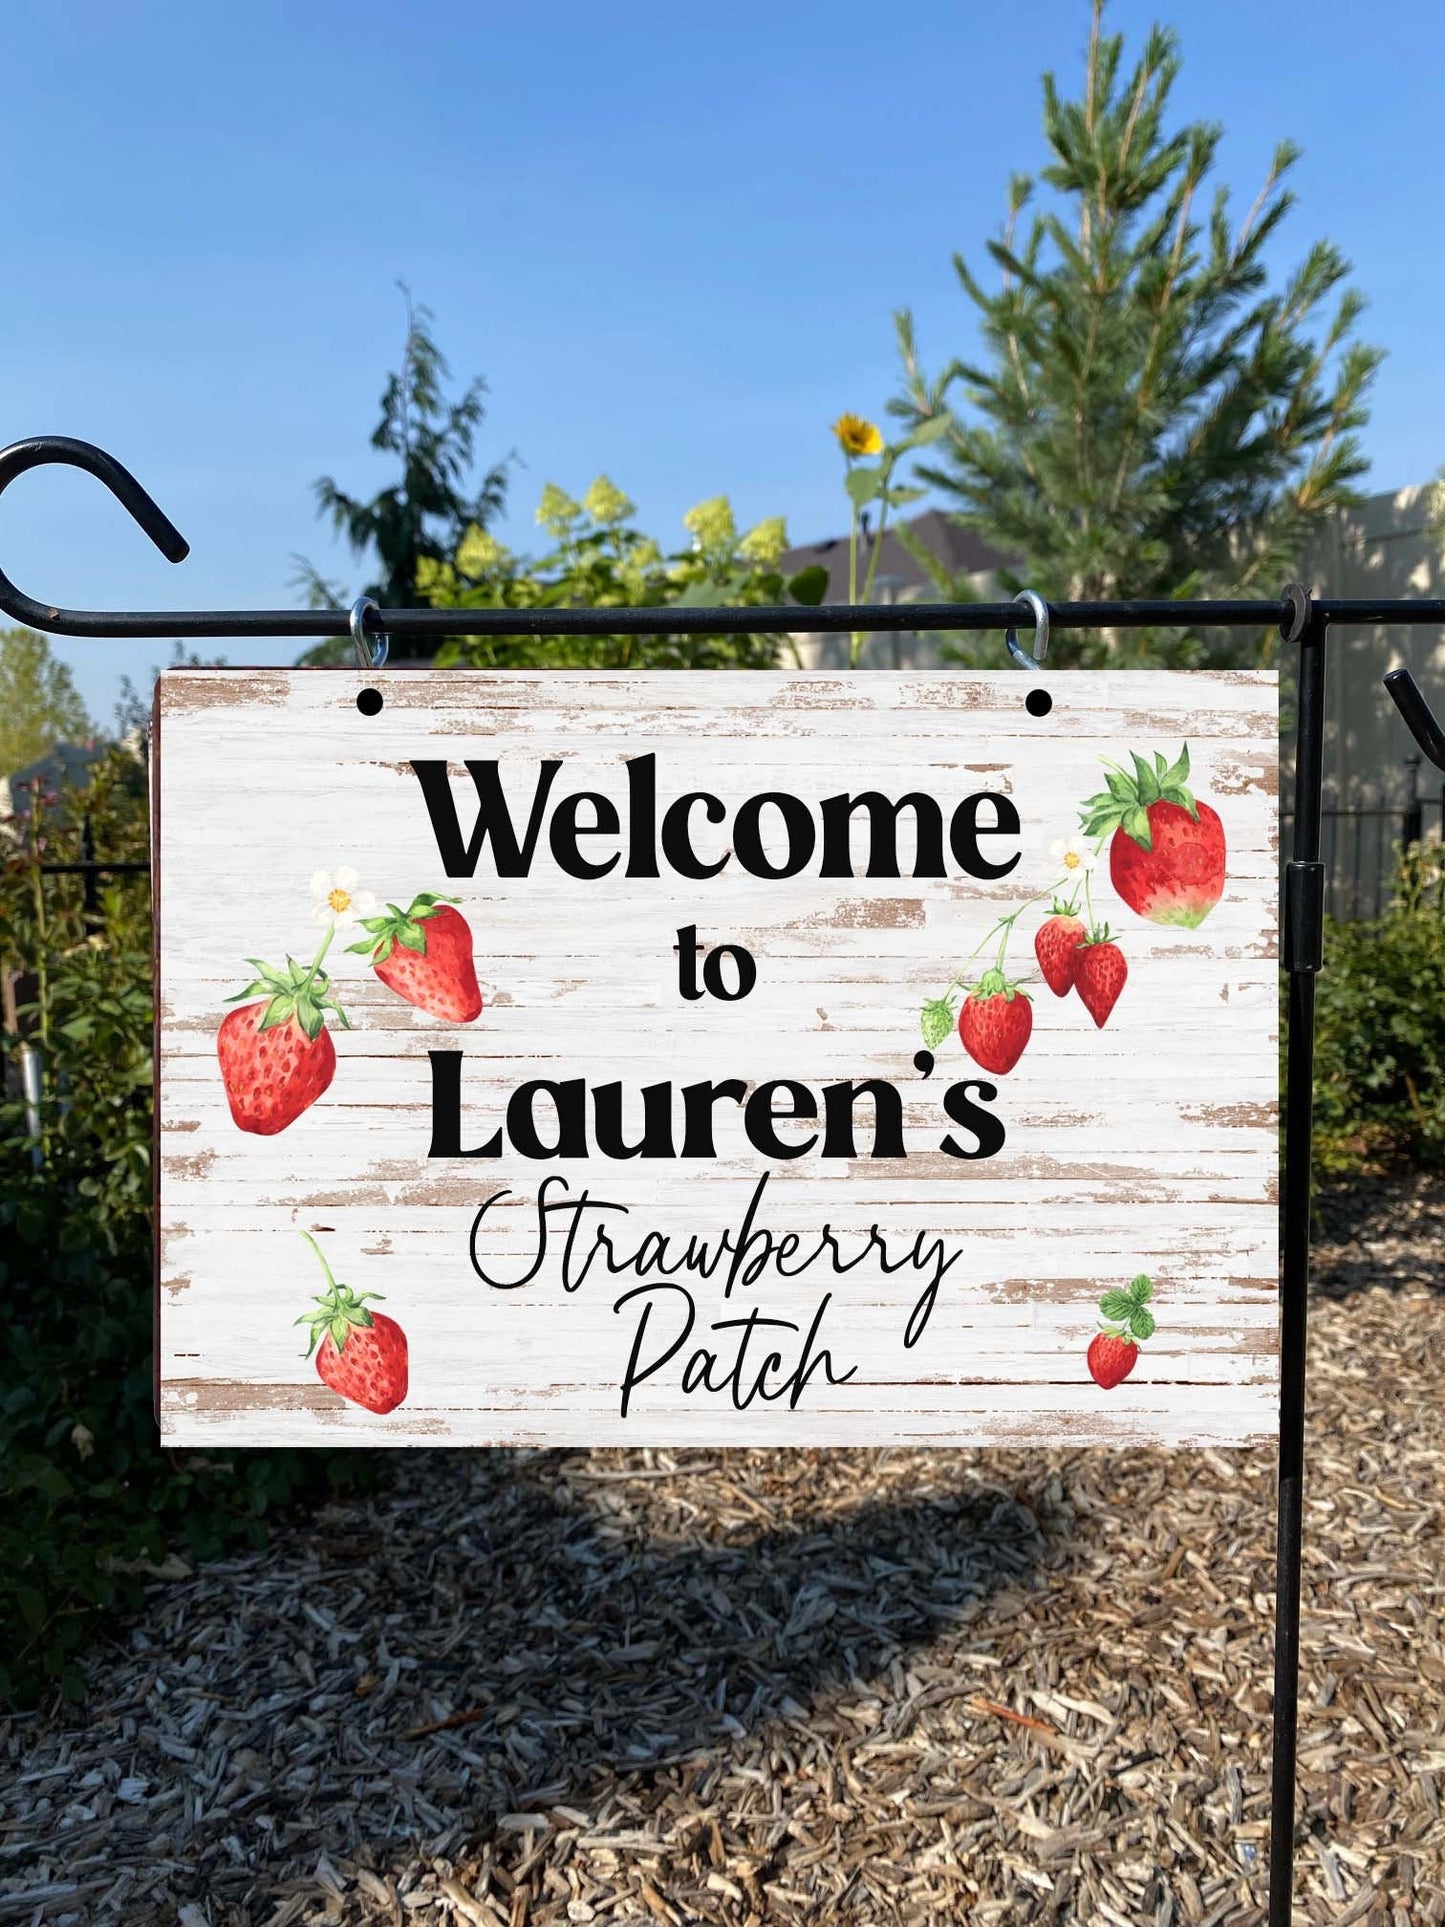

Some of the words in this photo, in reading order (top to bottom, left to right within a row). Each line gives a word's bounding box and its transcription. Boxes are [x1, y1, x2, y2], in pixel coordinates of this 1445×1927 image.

[409, 752, 1022, 880] Welcome
[672, 924, 757, 1002] to
[427, 1049, 1006, 1160] Lauren's
[469, 1170, 964, 1349] Strawberry
[613, 1282, 858, 1419] Patch
